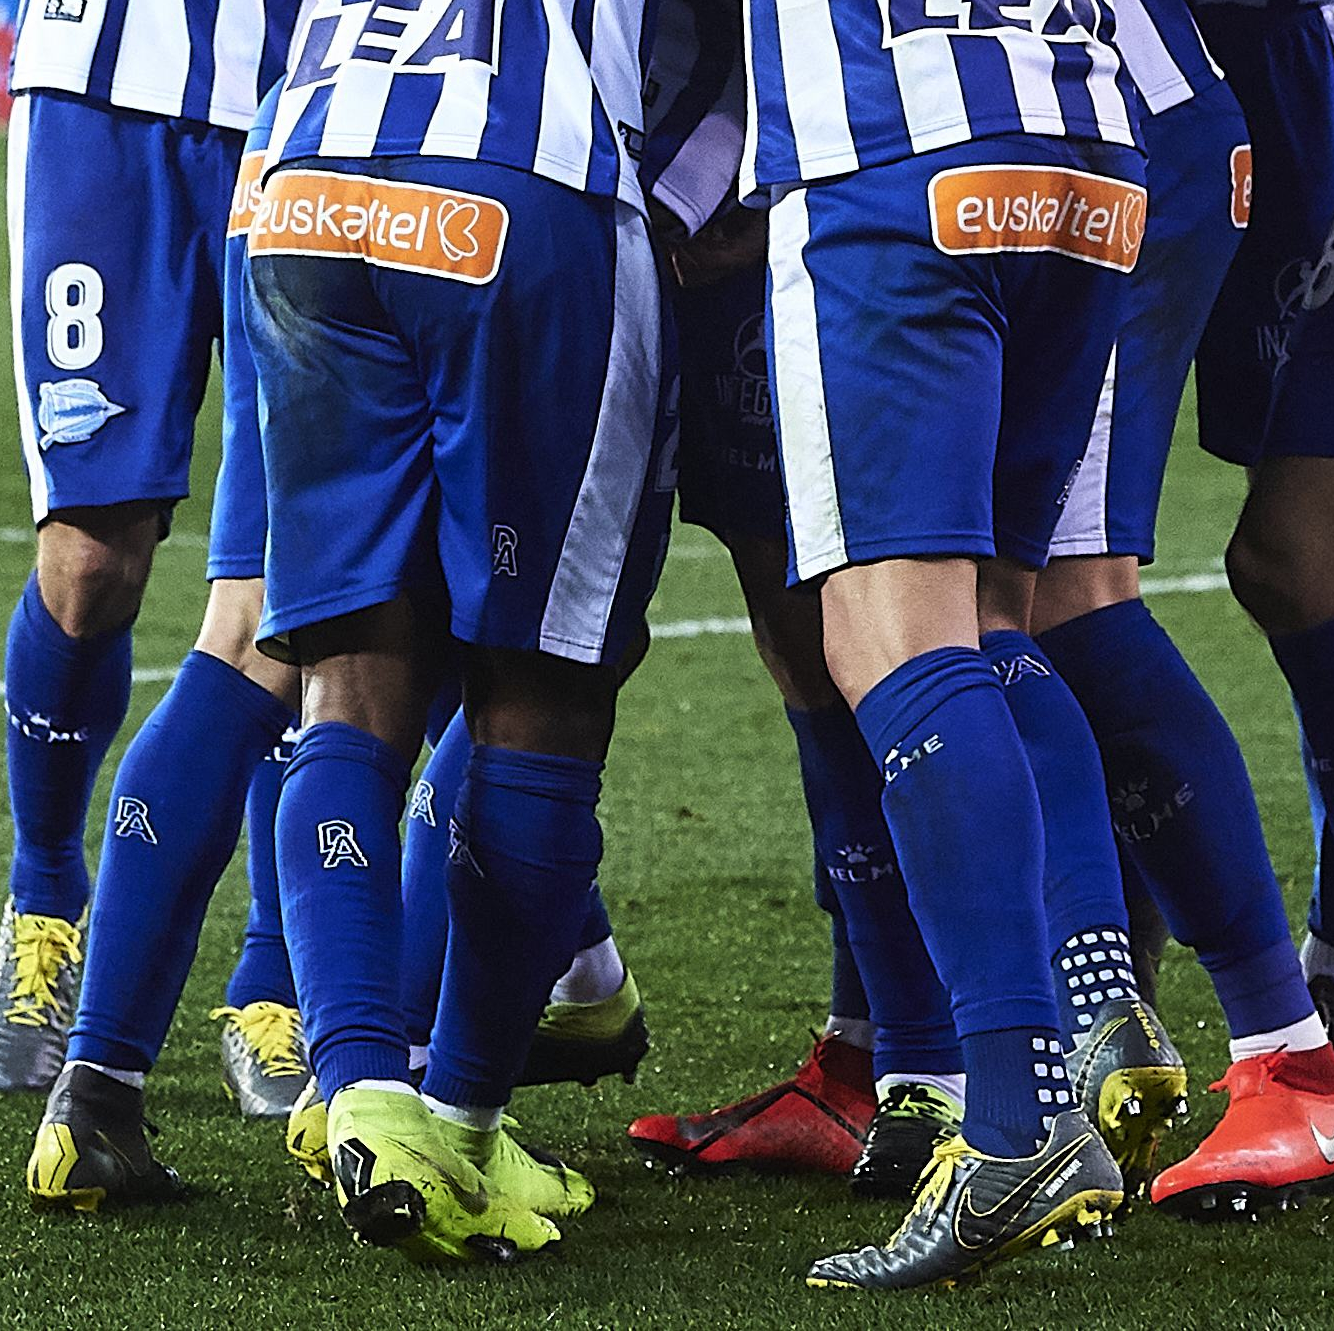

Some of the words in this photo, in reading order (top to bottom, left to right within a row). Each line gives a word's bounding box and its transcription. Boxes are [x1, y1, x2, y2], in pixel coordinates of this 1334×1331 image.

[254, 194, 429, 251] euskaltel
[956, 190, 1120, 246] euskaltel
[45, 262, 104, 370] 8
